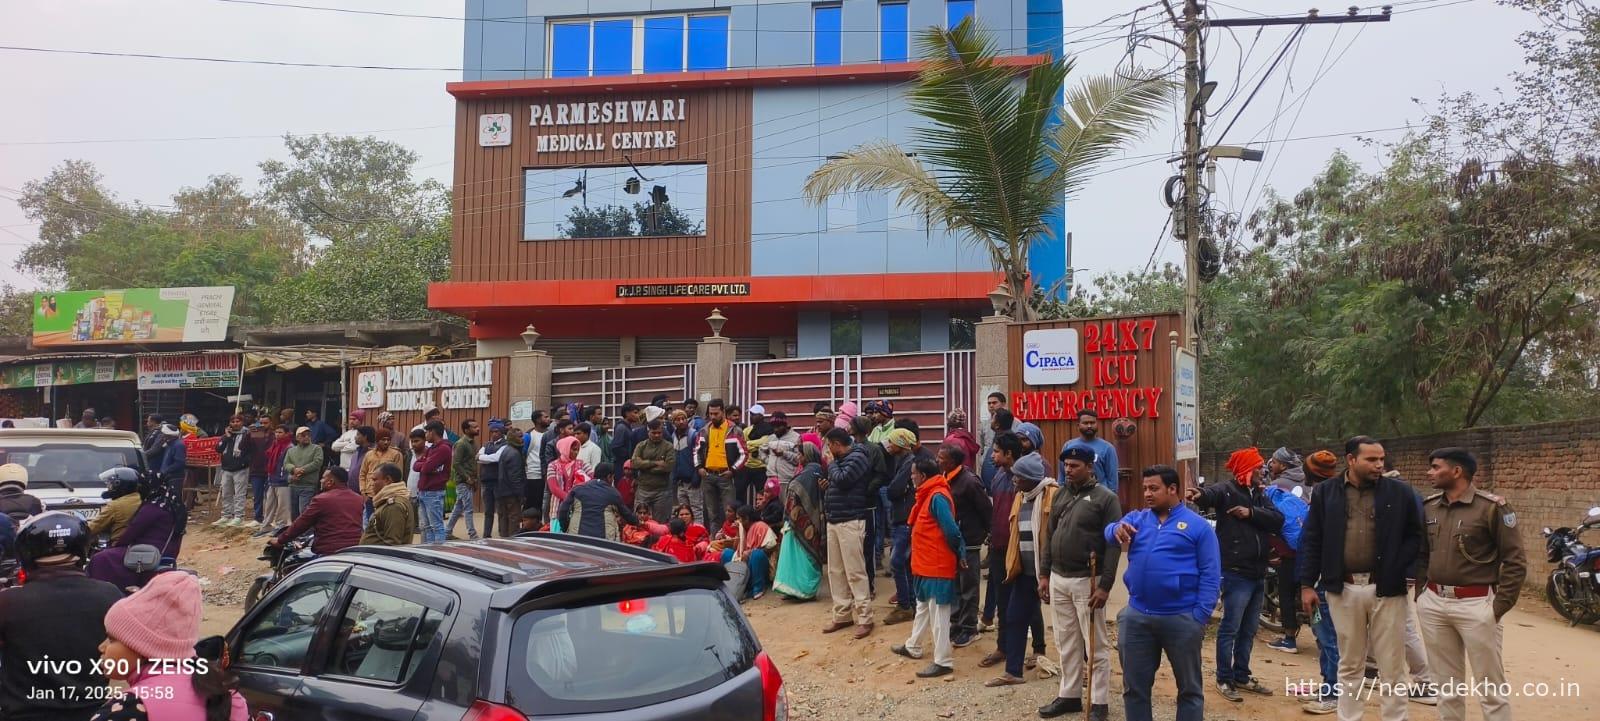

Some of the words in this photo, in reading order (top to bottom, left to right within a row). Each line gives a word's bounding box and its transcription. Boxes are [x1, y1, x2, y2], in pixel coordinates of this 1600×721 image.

[529, 99, 686, 126] PARMESHWARI
[537, 133, 605, 152] MEDICAL
[612, 131, 677, 149] CENTRE
[643, 285, 667, 296] SINGH
[669, 285, 687, 295] LIFE
[687, 285, 710, 295] CARE
[711, 285, 729, 294] PVT.
[730, 284, 747, 294] LTD.
[1084, 320, 1157, 352] 24X7
[138, 356, 159, 372] YASH
[161, 355, 206, 371] COMPUTER
[208, 354, 237, 370] WORLD
[1026, 350, 1074, 368] CIPACA
[1092, 355, 1137, 387] ICU
[386, 360, 493, 390] PARMESHWARI
[387, 390, 435, 411] MEDICAL
[441, 388, 491, 409] CENTRE
[1011, 388, 1163, 420] EMERGENCY
